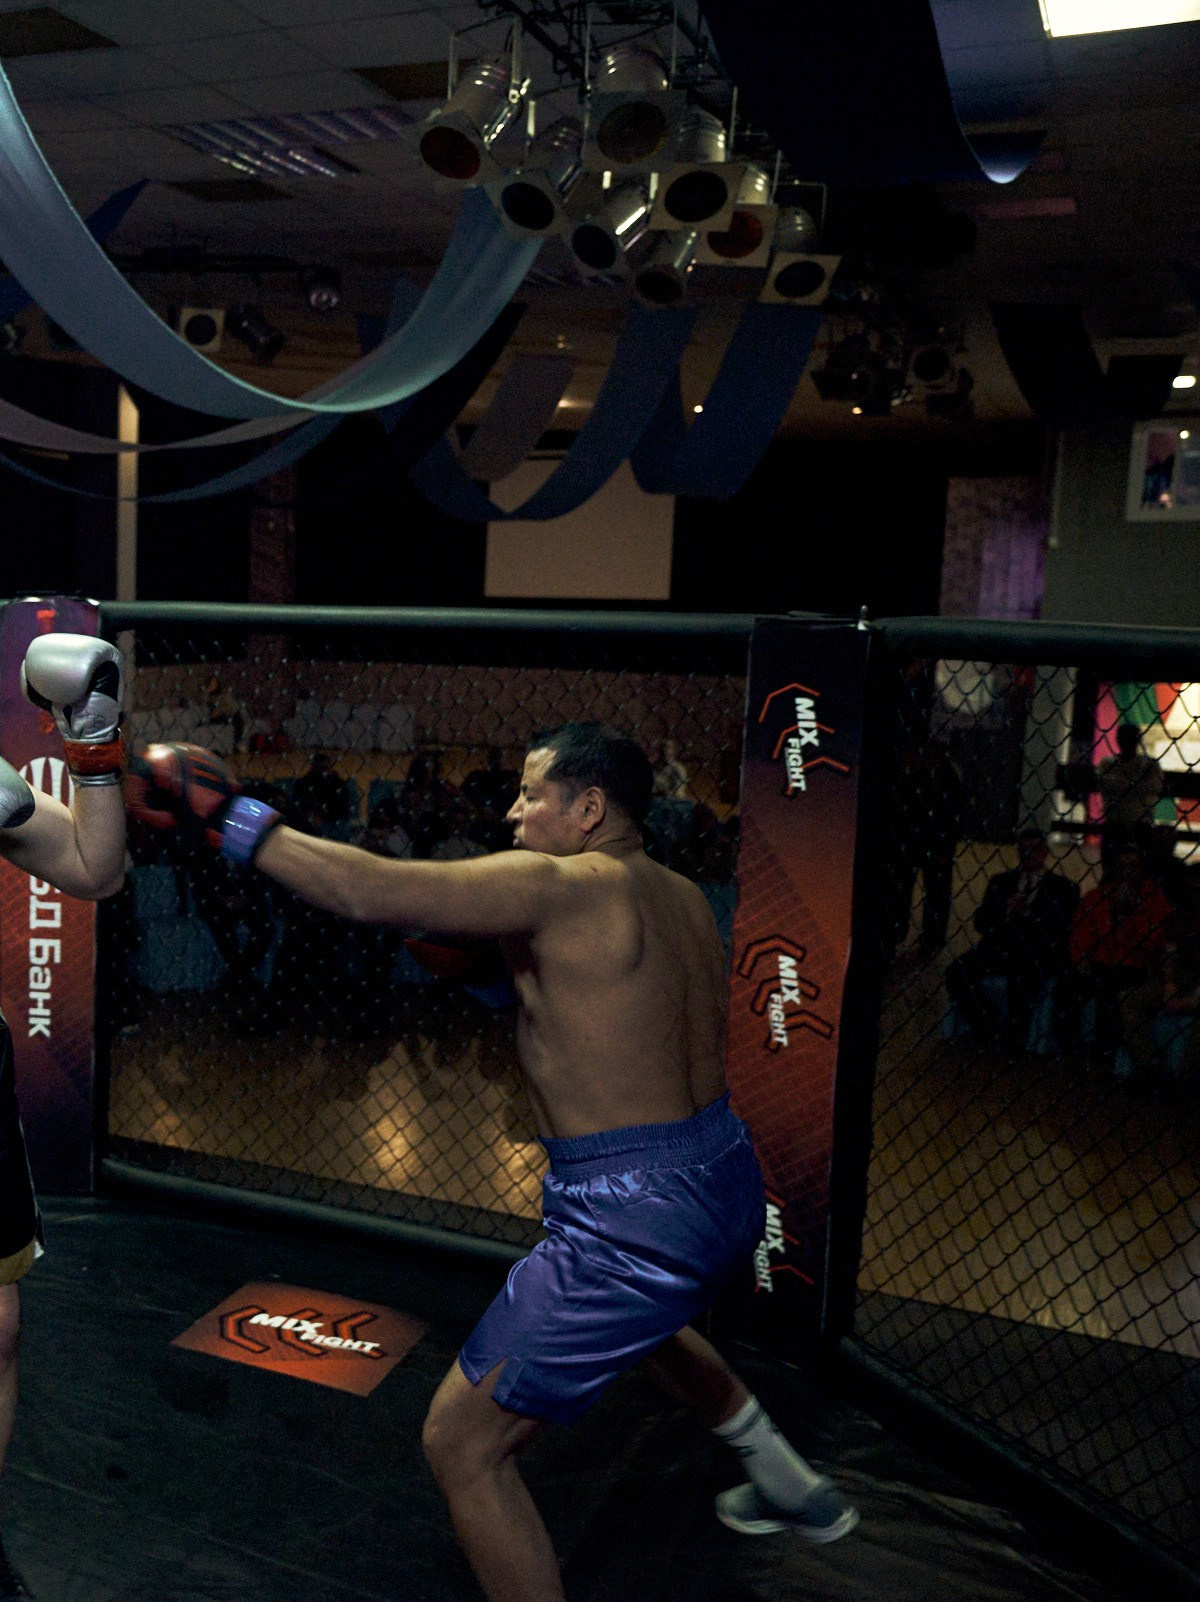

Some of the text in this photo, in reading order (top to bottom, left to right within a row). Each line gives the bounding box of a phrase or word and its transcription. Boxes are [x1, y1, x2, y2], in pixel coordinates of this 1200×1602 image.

[794, 697, 820, 747] MIX
[786, 737, 807, 791] FIGHT
[28, 938, 62, 1038] Банк
[778, 955, 801, 1005] MIX
[768, 993, 789, 1047] FIGHT
[765, 1202, 786, 1254] MIX
[249, 1313, 325, 1334] MIX
[300, 1332, 381, 1353] FIGHT
